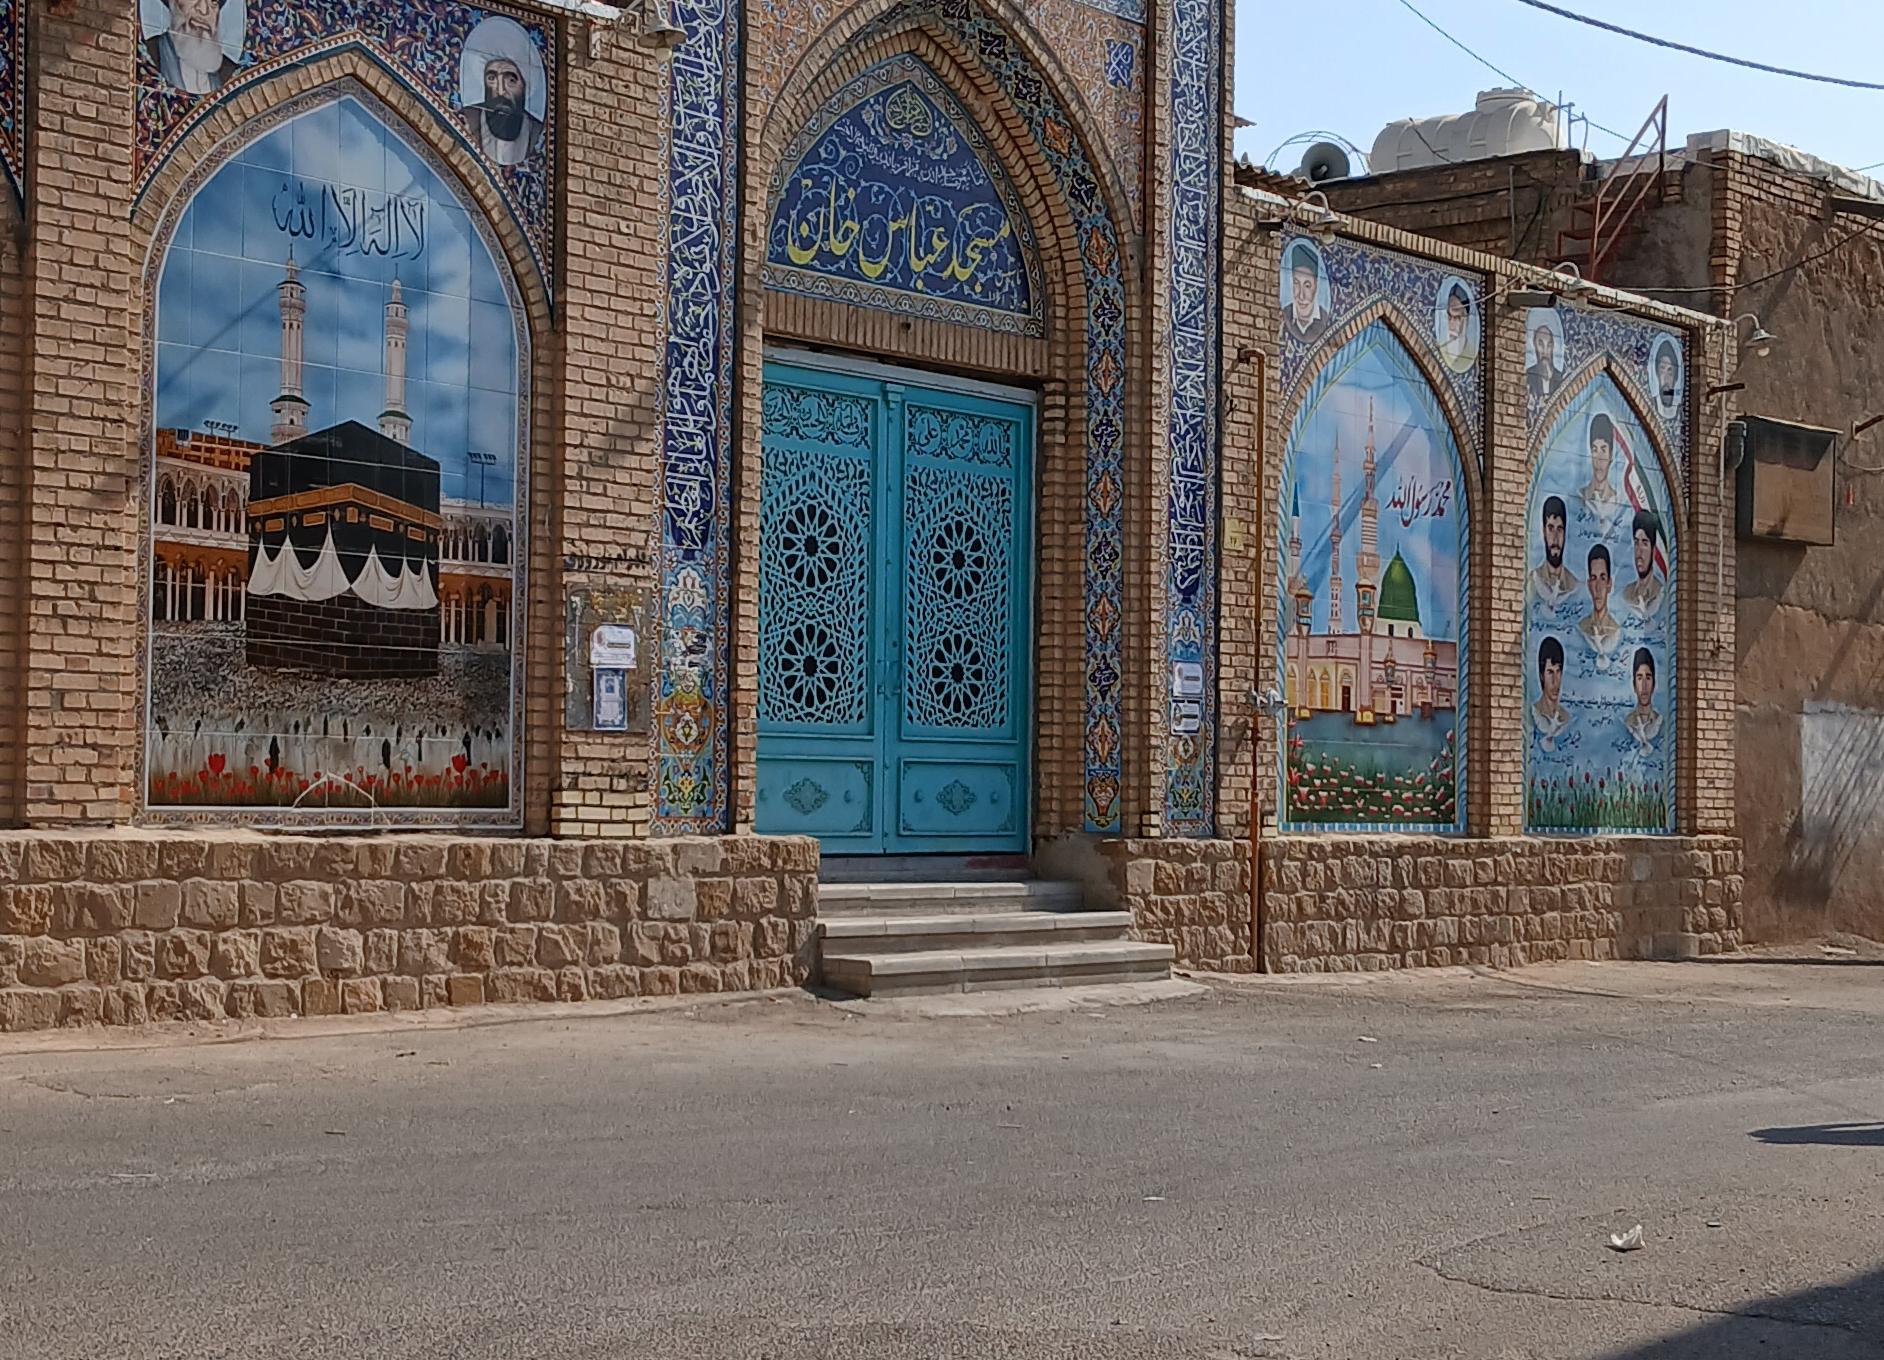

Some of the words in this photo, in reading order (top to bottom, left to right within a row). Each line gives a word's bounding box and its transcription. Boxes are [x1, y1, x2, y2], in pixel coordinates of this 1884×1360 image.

[272, 181, 326, 239] الله
[787, 177, 861, 265] خان
[858, 200, 950, 291] عباس
[943, 215, 1011, 293] مسجد
[1384, 473, 1411, 510] الله
[1400, 478, 1432, 528] رسول
